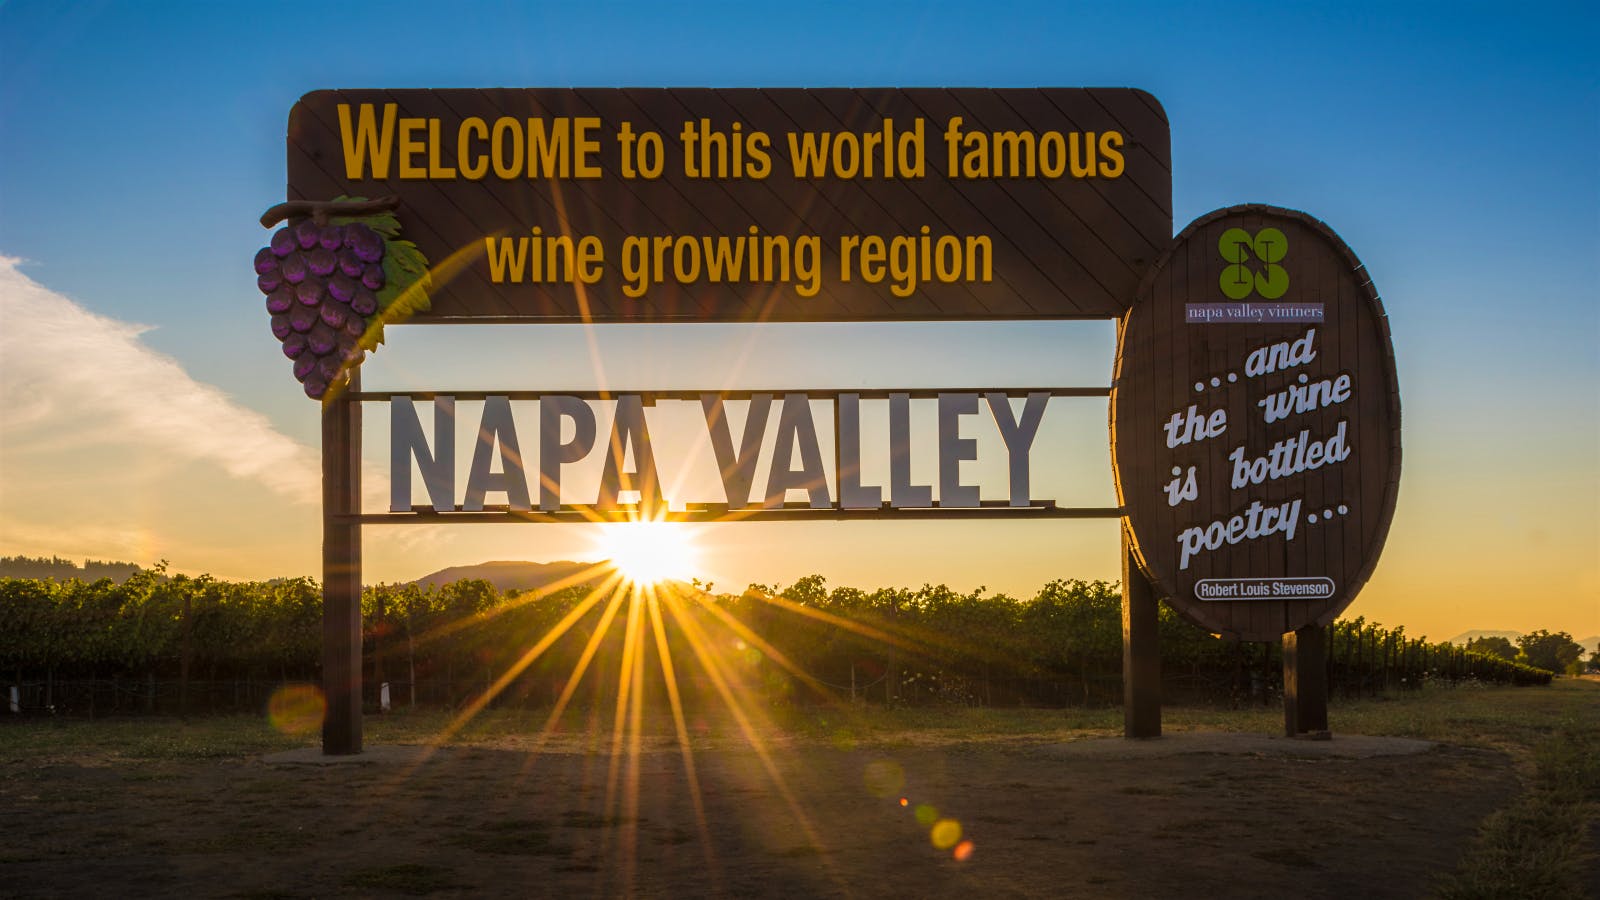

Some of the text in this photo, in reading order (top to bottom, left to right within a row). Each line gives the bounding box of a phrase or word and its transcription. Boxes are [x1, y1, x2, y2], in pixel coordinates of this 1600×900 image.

[337, 103, 1125, 180] WELCOME to this world famous
[485, 226, 993, 297] wine growing region
[1188, 304, 1323, 321] napa valley vintners
[1164, 374, 1351, 448] the wine
[390, 392, 1051, 512] NAPA VALLEY
[1164, 421, 1350, 506] is bottled
[1201, 581, 1329, 597] Robert Louis Stevenson
